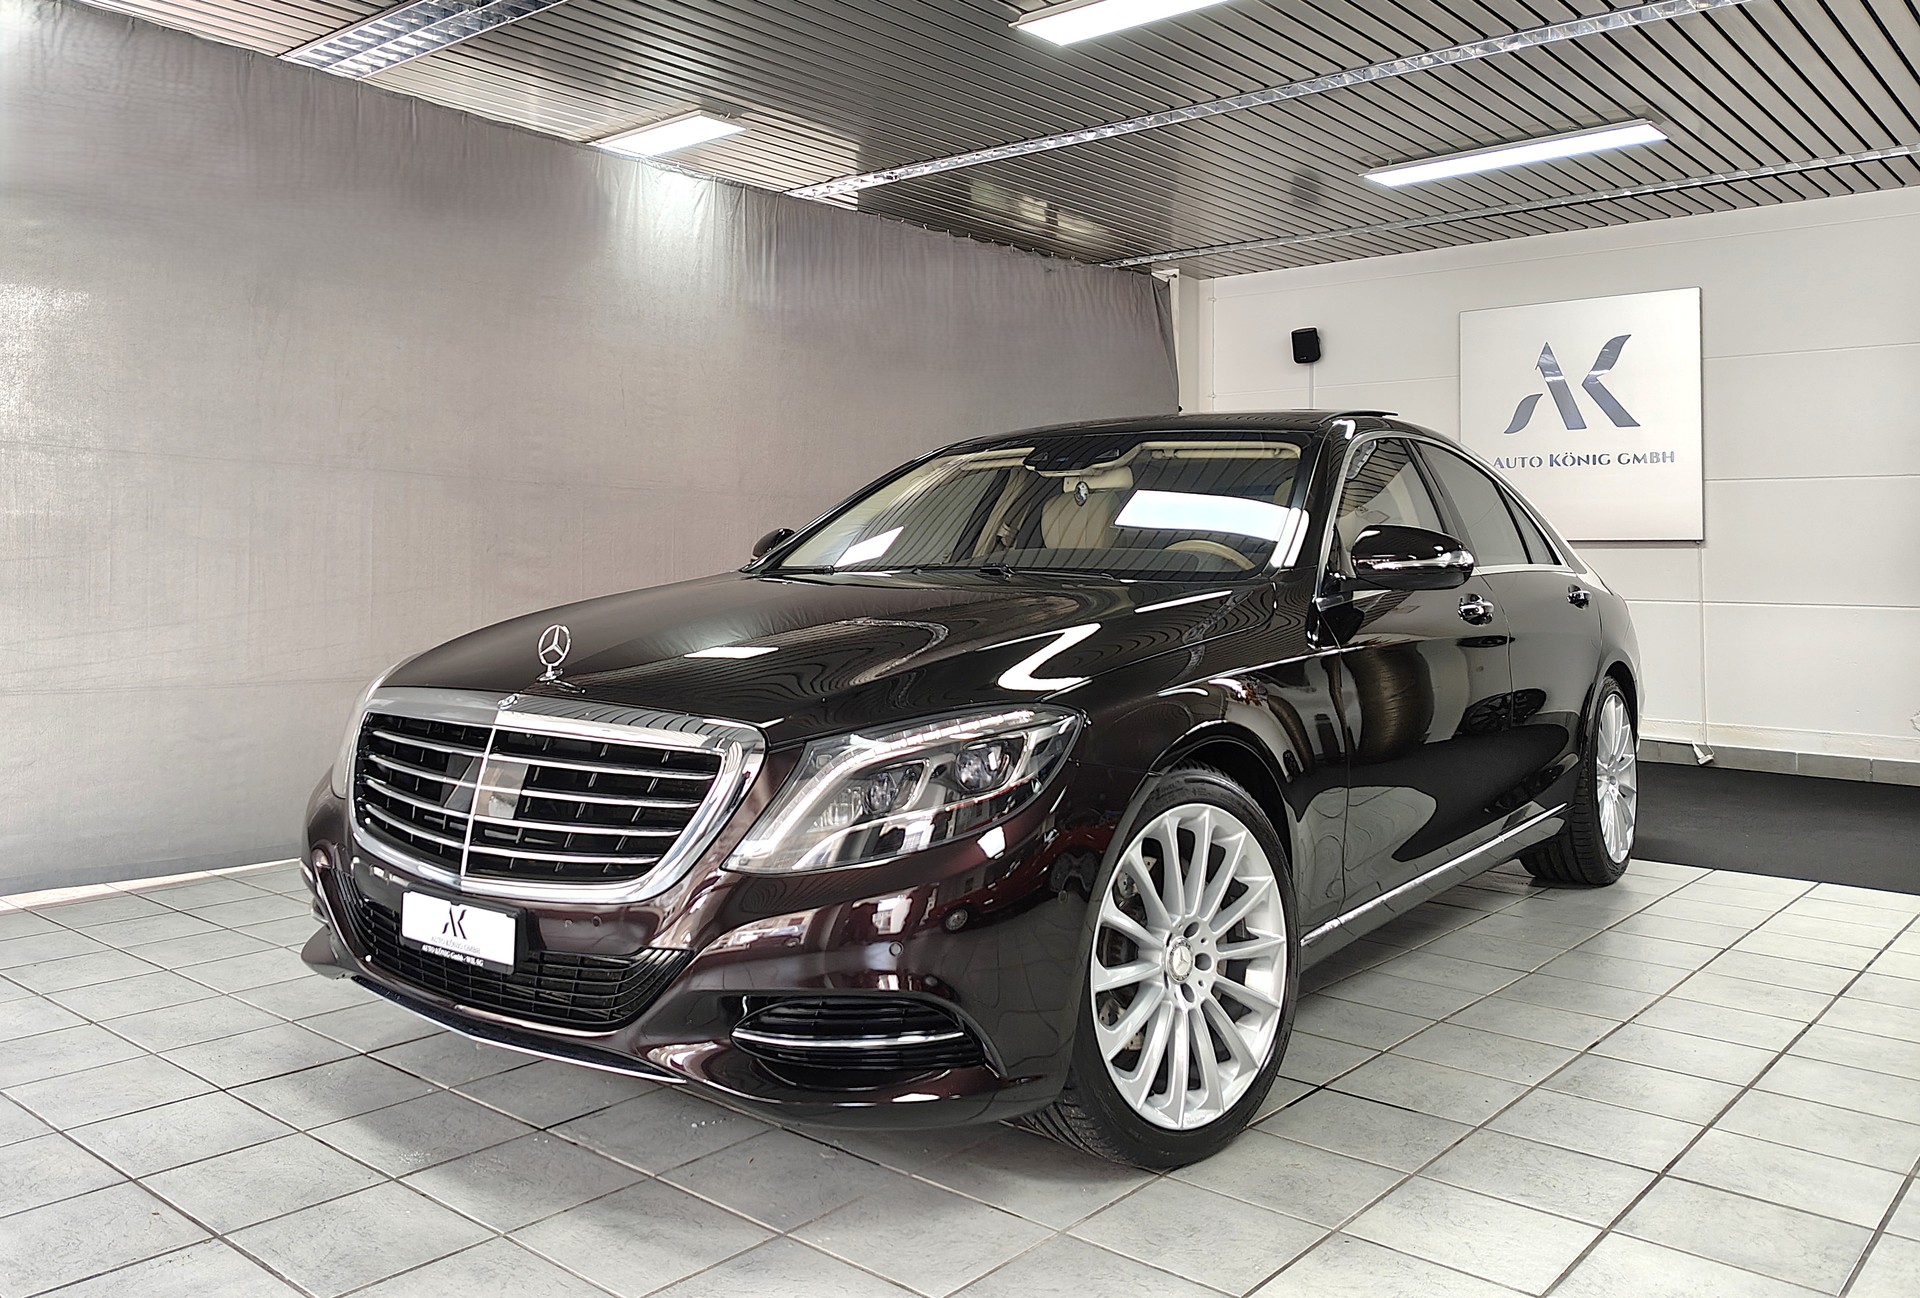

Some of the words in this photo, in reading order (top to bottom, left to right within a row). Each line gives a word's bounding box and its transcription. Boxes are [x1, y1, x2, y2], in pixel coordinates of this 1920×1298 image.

[1493, 455, 1544, 469] AUTO
[1549, 452, 1611, 468] KÖNIG
[1617, 451, 1675, 466] GMBH
